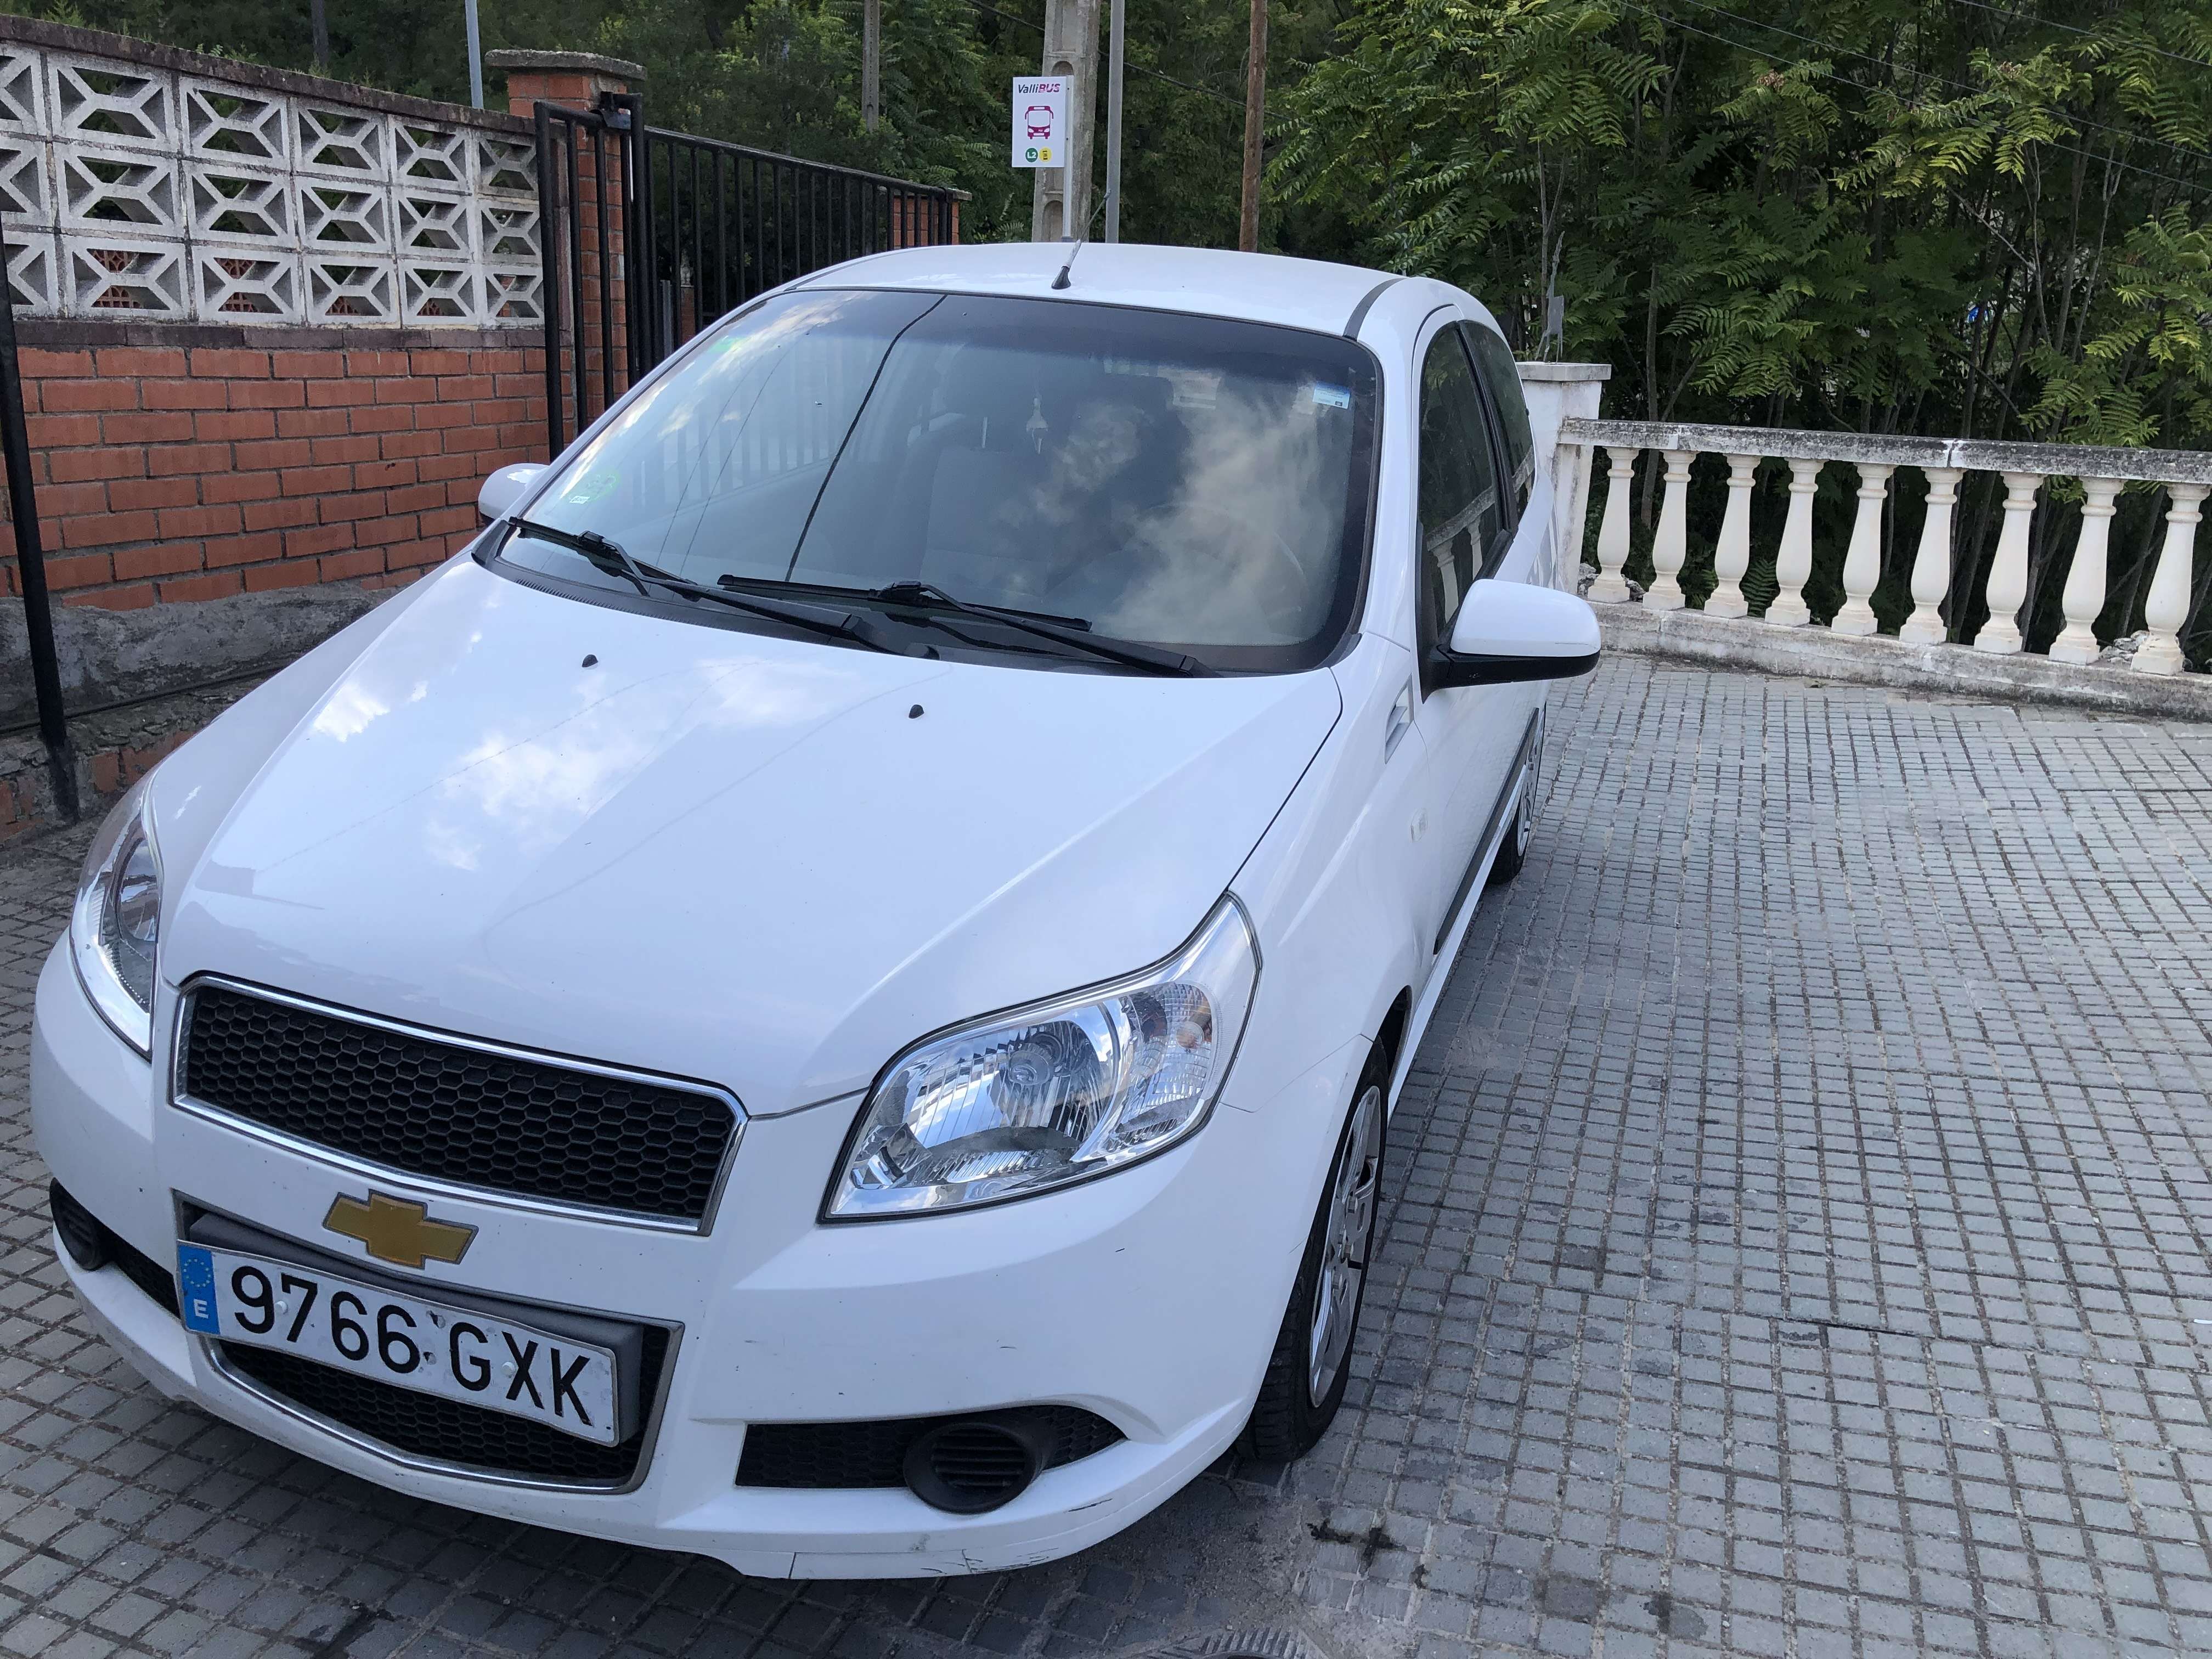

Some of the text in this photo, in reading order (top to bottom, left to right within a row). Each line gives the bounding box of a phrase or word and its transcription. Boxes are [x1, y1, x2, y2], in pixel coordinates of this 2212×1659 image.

[1018, 83, 1060, 94] ValliBUS
[193, 1299, 209, 1319] E
[230, 1266, 595, 1426] 9766 GXK
